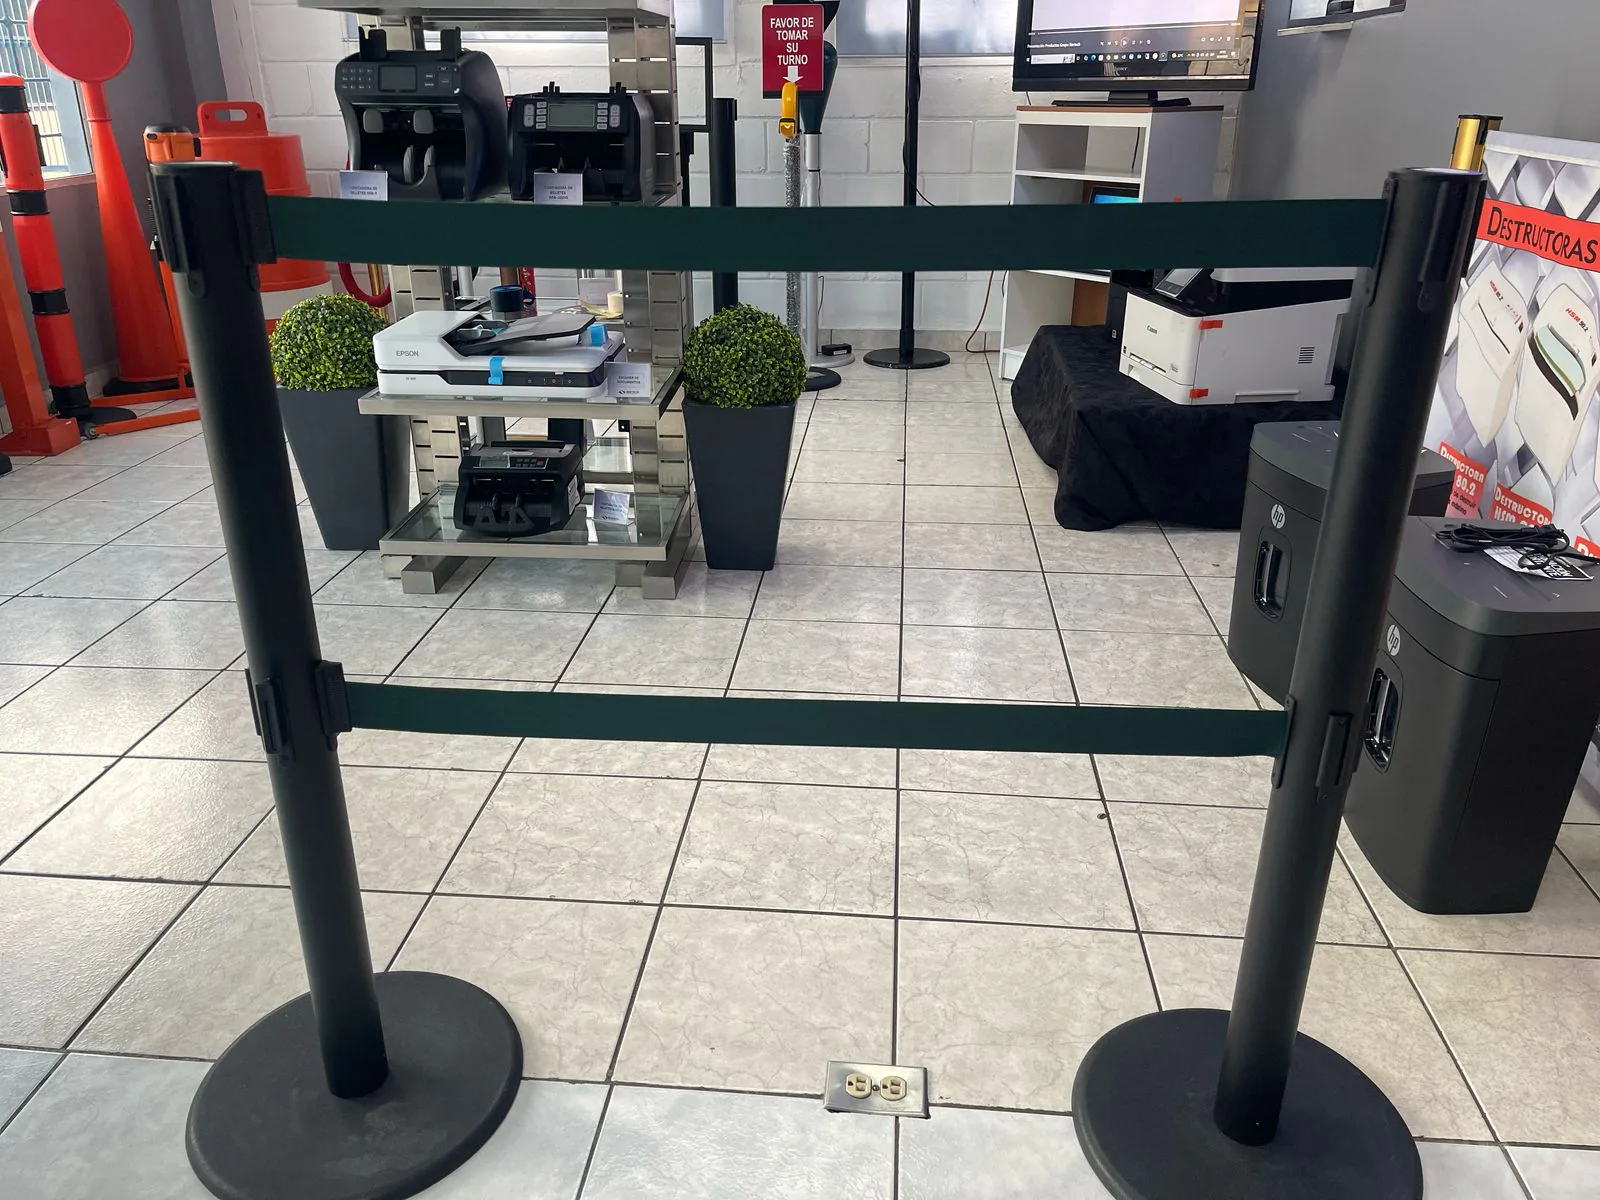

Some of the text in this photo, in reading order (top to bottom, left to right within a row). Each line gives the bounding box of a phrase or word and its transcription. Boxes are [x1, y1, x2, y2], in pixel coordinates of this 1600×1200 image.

[770, 17, 814, 28] FAVOR DE
[776, 30, 808, 41] TOMAR
[786, 42, 799, 53] SU
[777, 54, 808, 65] TURNO
[1486, 206, 1598, 264] DESTRUCTORAS
[1565, 307, 1581, 323] HSM
[1456, 475, 1476, 496] 80.2
[1272, 504, 1285, 528] hp
[1388, 625, 1400, 653] hp
